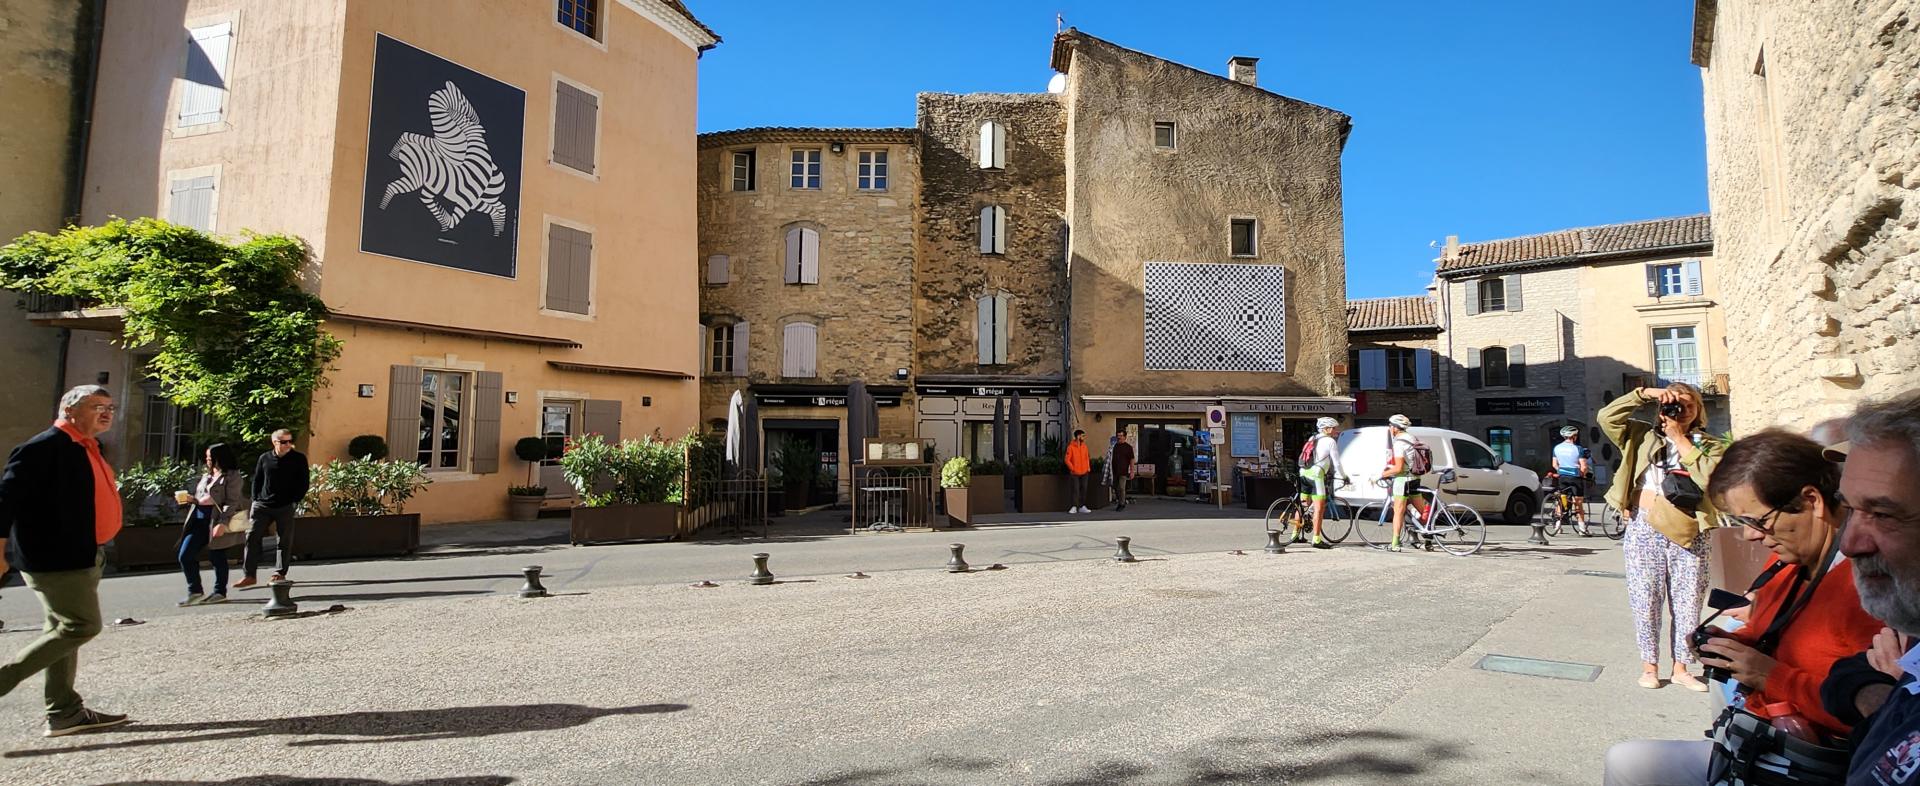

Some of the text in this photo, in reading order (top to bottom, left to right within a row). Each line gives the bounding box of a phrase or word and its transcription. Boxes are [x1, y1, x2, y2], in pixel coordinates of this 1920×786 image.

[972, 387, 1004, 396] L'Artégal
[811, 397, 845, 406] L'Artégal
[1516, 399, 1550, 407] Sotheby's
[1126, 402, 1175, 411] SOUVENIRS
[1291, 404, 1325, 412] PEYRON
